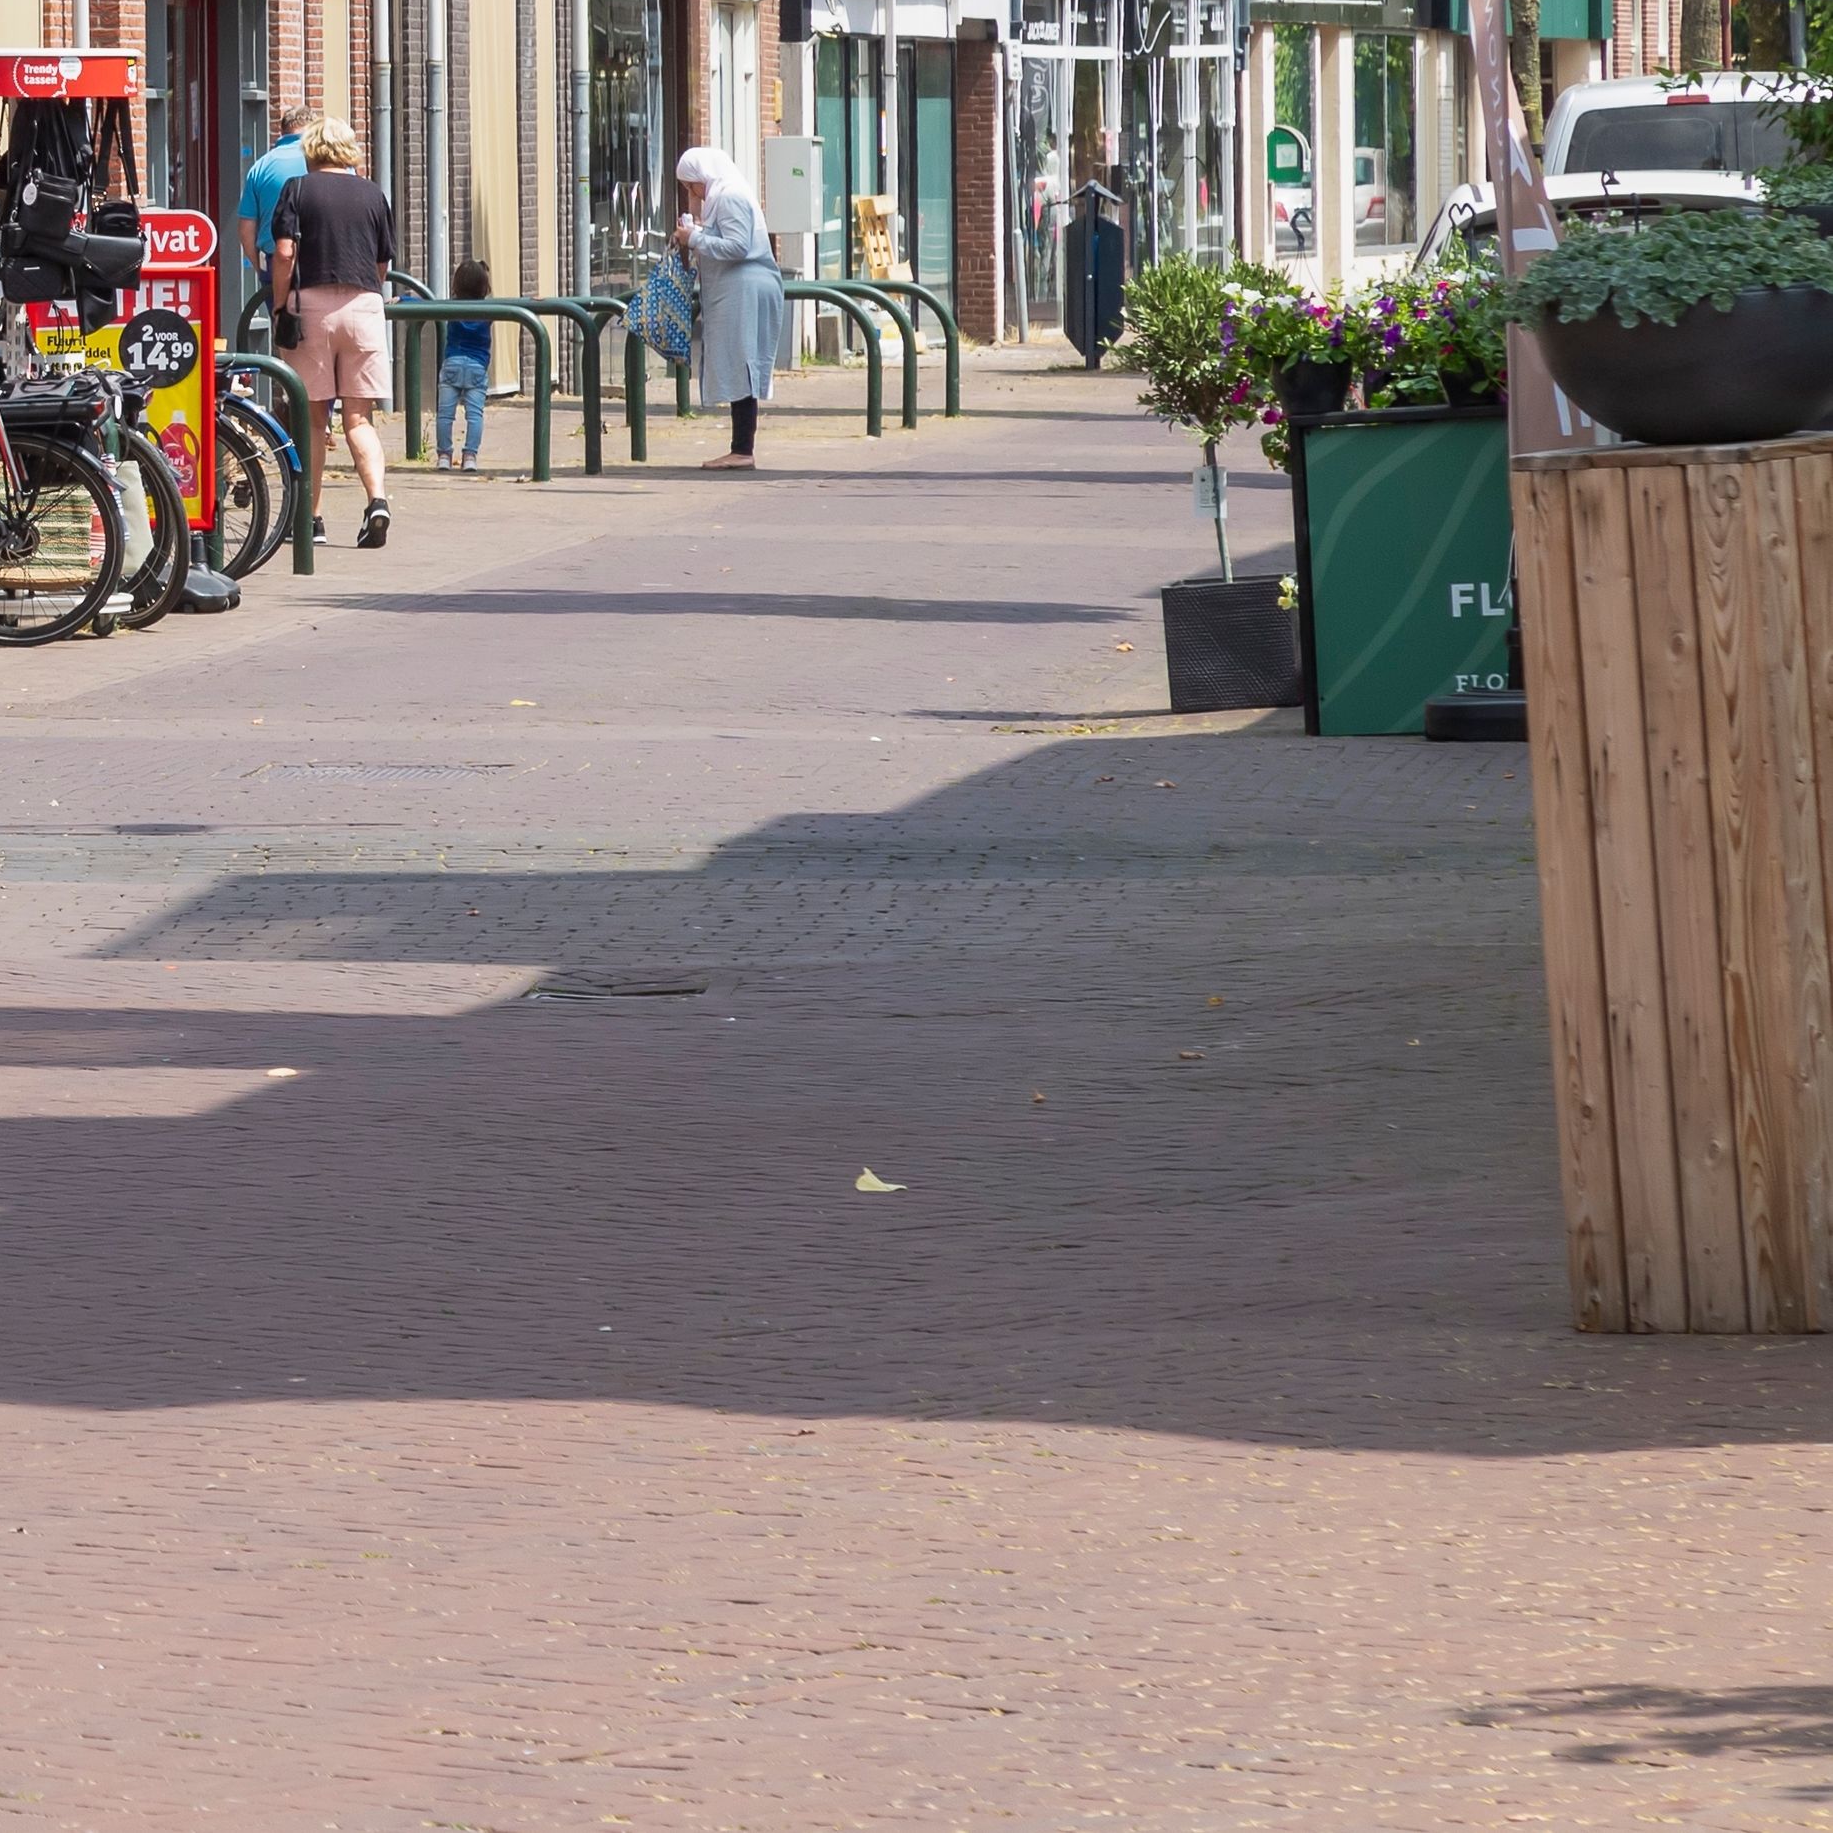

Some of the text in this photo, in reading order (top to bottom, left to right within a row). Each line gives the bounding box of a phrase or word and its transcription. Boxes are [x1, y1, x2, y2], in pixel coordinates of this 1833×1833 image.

[23, 63, 58, 76] Trendy
[24, 74, 58, 85] tassen
[141, 325, 179, 341] 2 VOOR
[1449, 582, 1513, 618] FL
[1454, 673, 1509, 692] FLO
